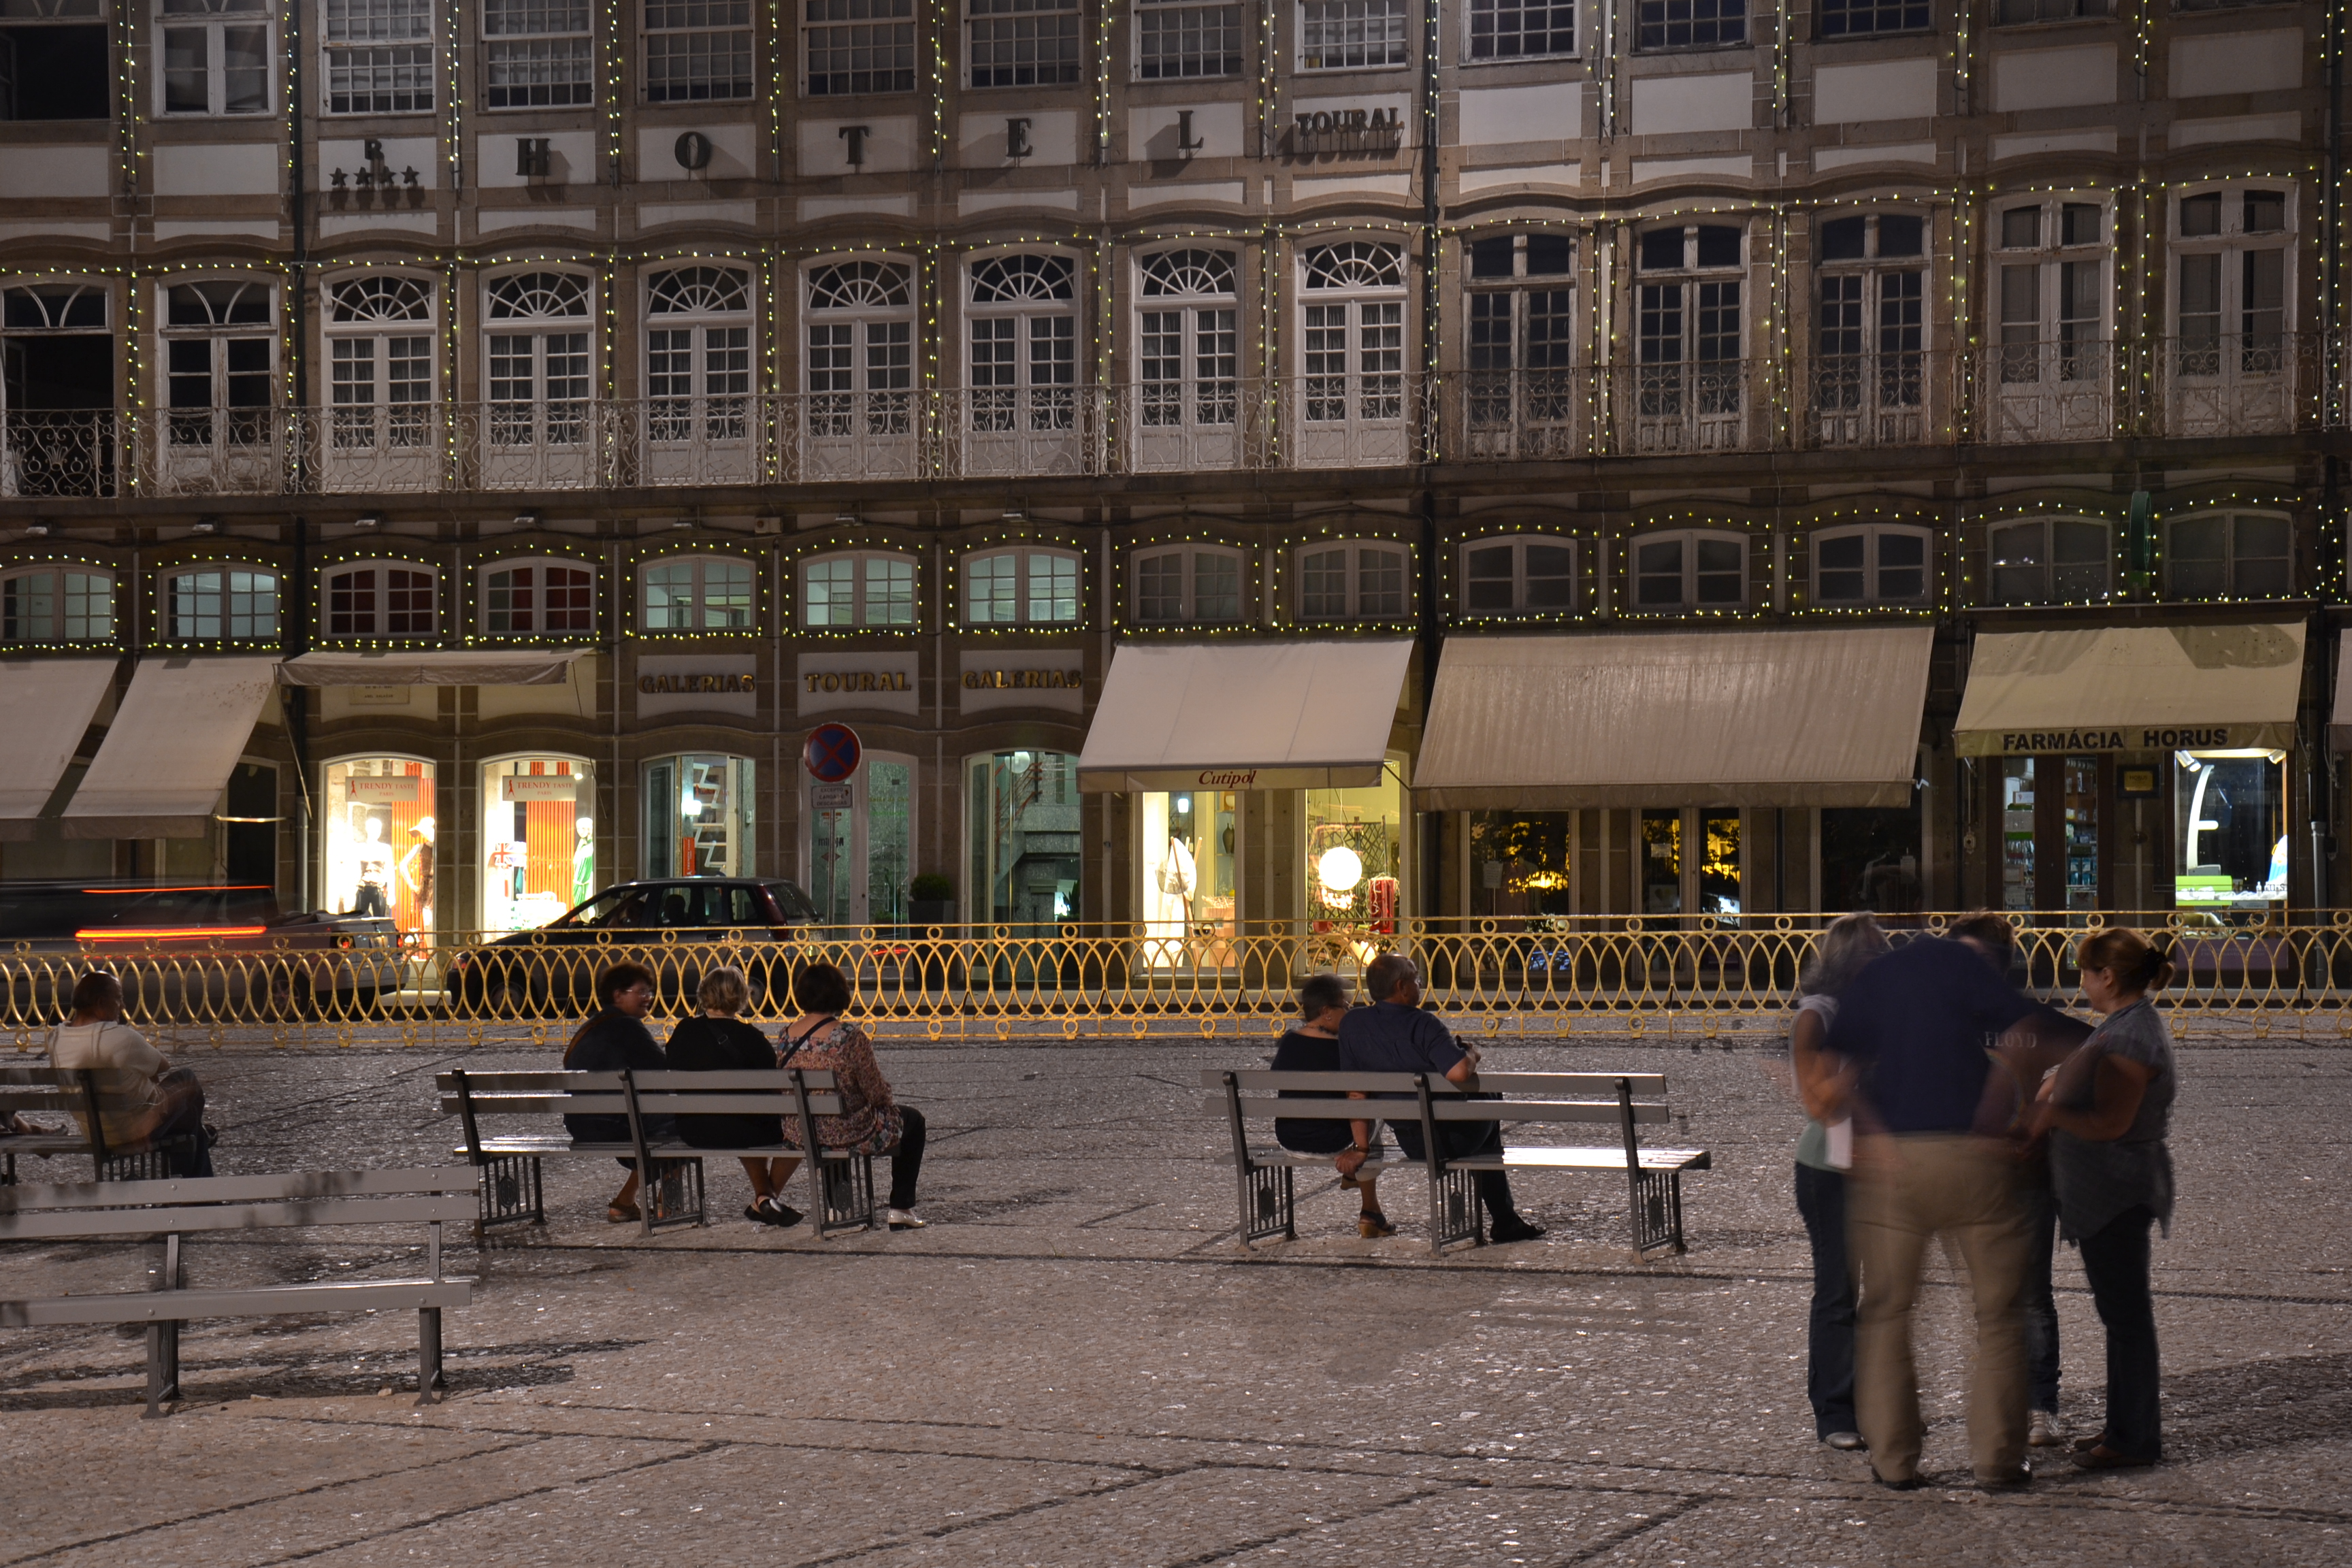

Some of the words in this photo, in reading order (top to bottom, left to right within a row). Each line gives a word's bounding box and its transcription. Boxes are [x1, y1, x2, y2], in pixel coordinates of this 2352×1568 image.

[1295, 107, 1405, 136] TOURAL
[637, 674, 755, 694] GALERIAS
[804, 672, 912, 692] TOURAL
[961, 670, 1082, 689] GALERIAS
[2002, 729, 2124, 750] FARMÁCIA
[2144, 728, 2229, 747] HORUS
[1198, 770, 1257, 789] Cutipol
[1984, 1031, 2038, 1049] FLOYD
